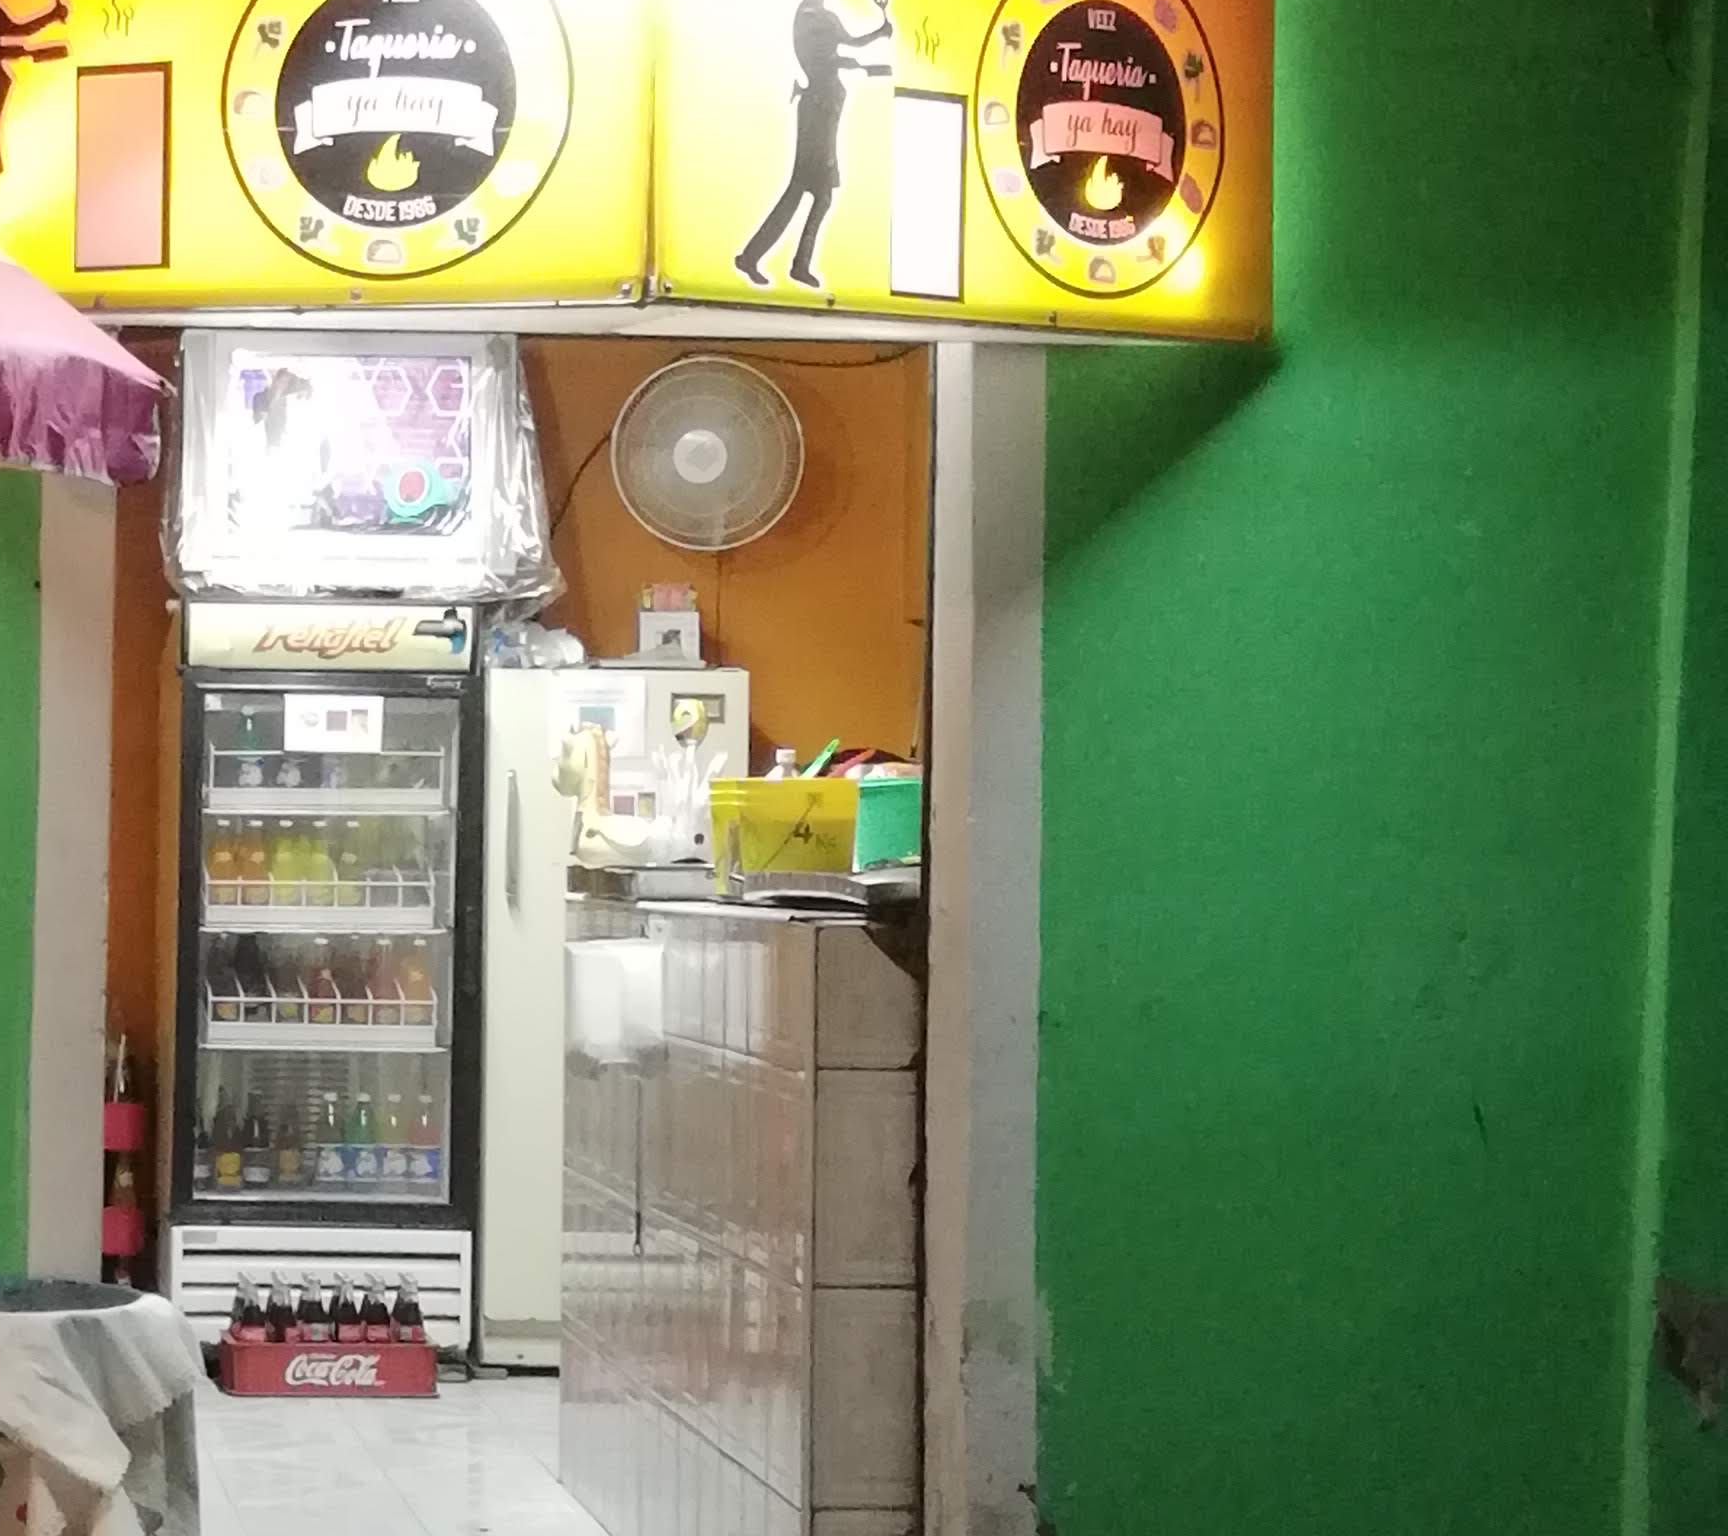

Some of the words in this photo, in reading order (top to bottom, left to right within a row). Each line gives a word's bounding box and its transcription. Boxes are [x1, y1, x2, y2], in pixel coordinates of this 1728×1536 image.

[347, 94, 378, 127] ya
[395, 86, 444, 126] hay
[1068, 114, 1092, 147] ya
[1101, 108, 1139, 154] hay
[343, 195, 397, 222] DESDE
